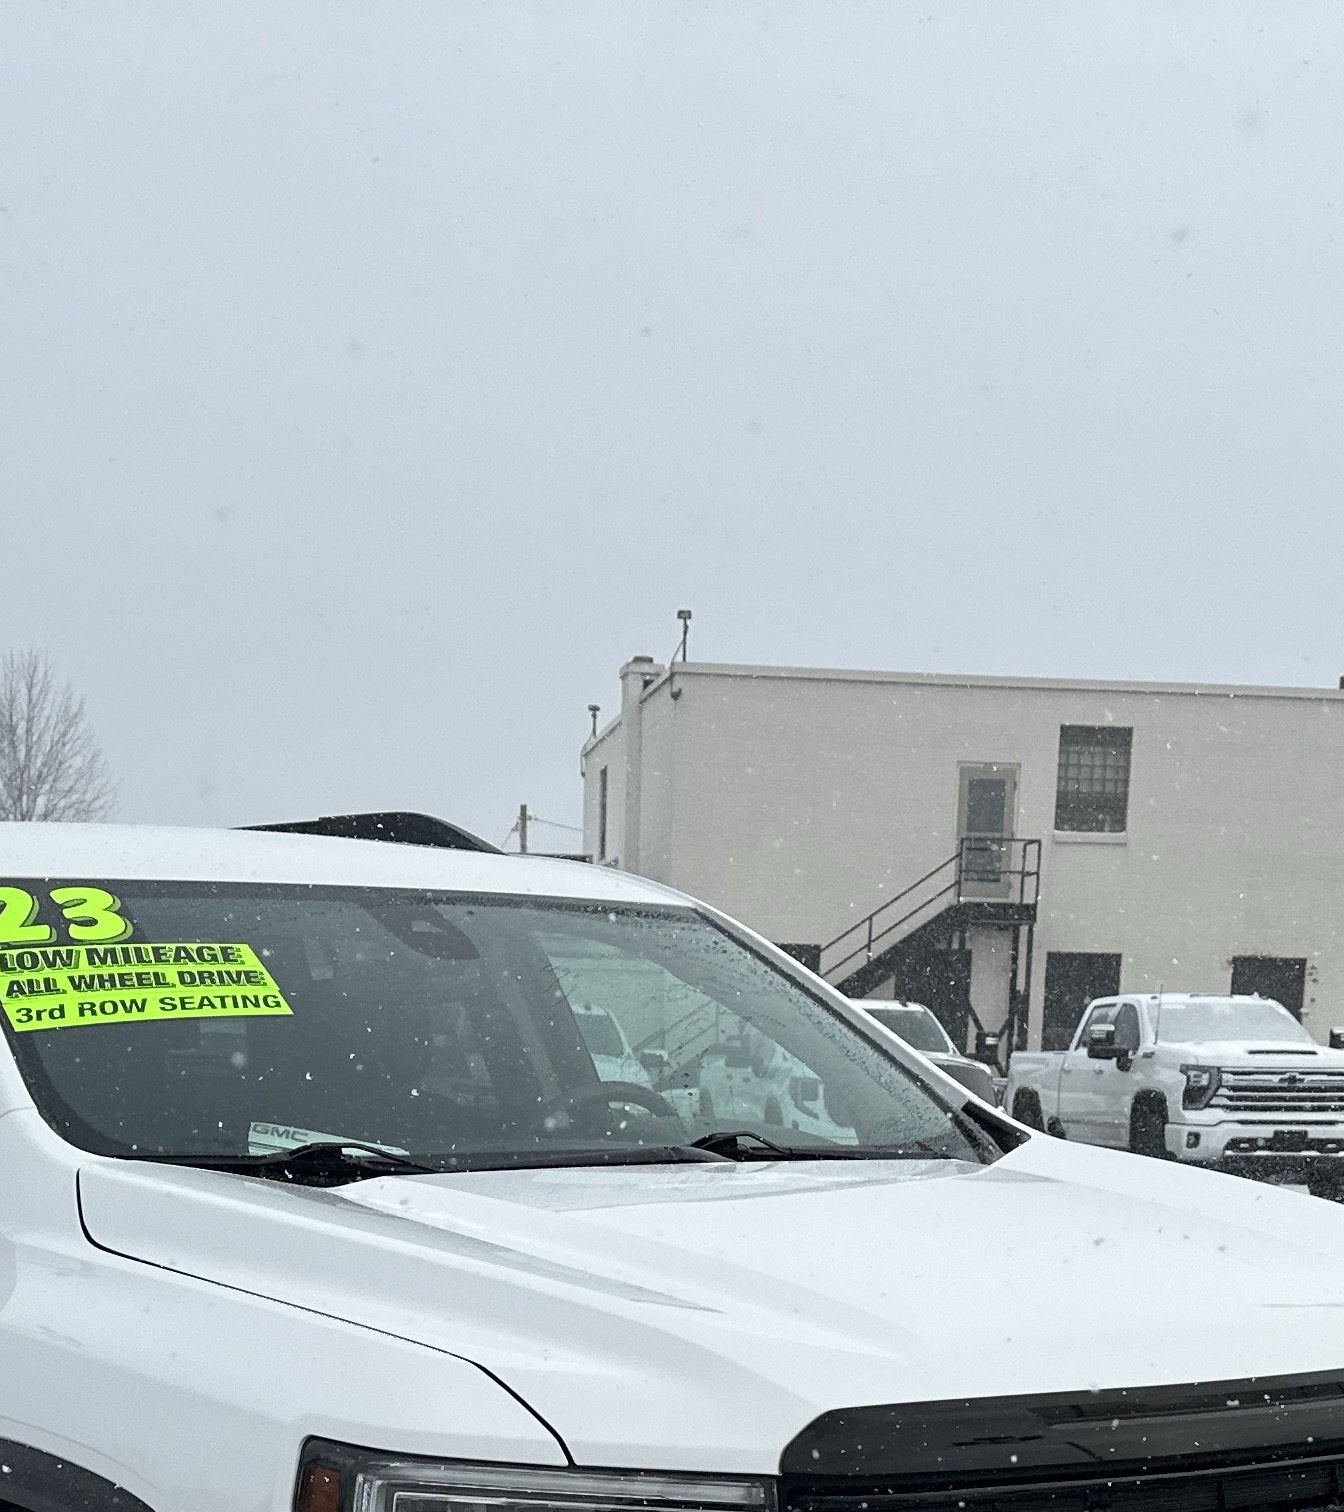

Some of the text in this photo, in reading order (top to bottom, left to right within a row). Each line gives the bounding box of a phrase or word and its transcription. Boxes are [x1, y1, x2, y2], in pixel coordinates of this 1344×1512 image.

[85, 946, 245, 968] MILEAGE
[6, 969, 267, 998] ALL WHEEL DRIVE
[15, 994, 282, 1024] 3rd ROW SEATING
[252, 1123, 309, 1143] GMC
